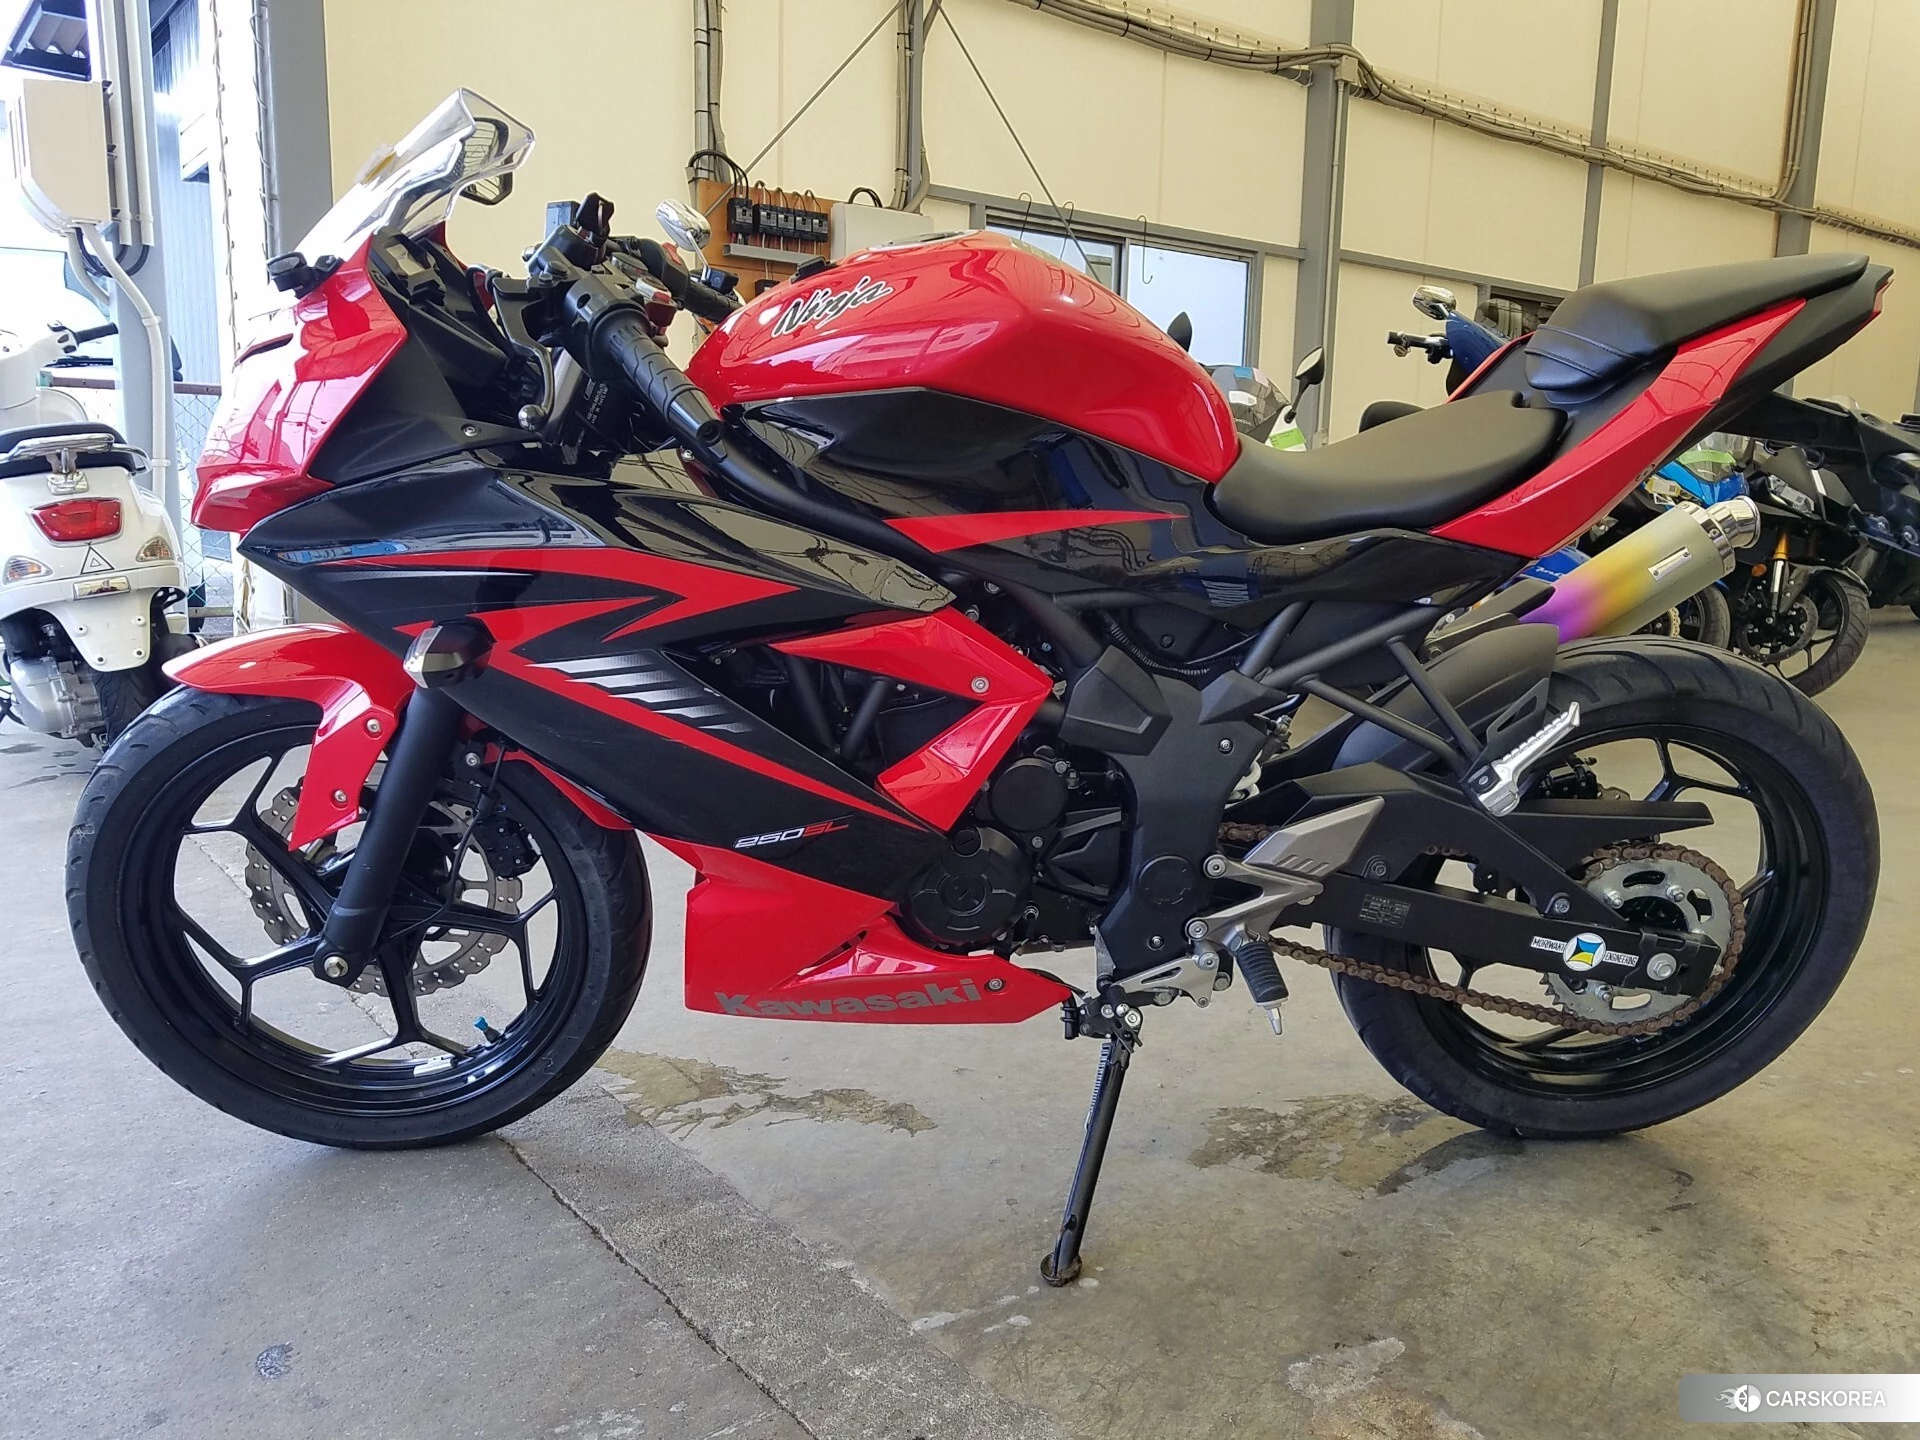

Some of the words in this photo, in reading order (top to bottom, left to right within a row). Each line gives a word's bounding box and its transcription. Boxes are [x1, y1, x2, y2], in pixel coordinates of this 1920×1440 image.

[771, 276, 893, 337] Ninja
[735, 822, 849, 848] 250SL
[714, 979, 982, 1016] Kawasaki
